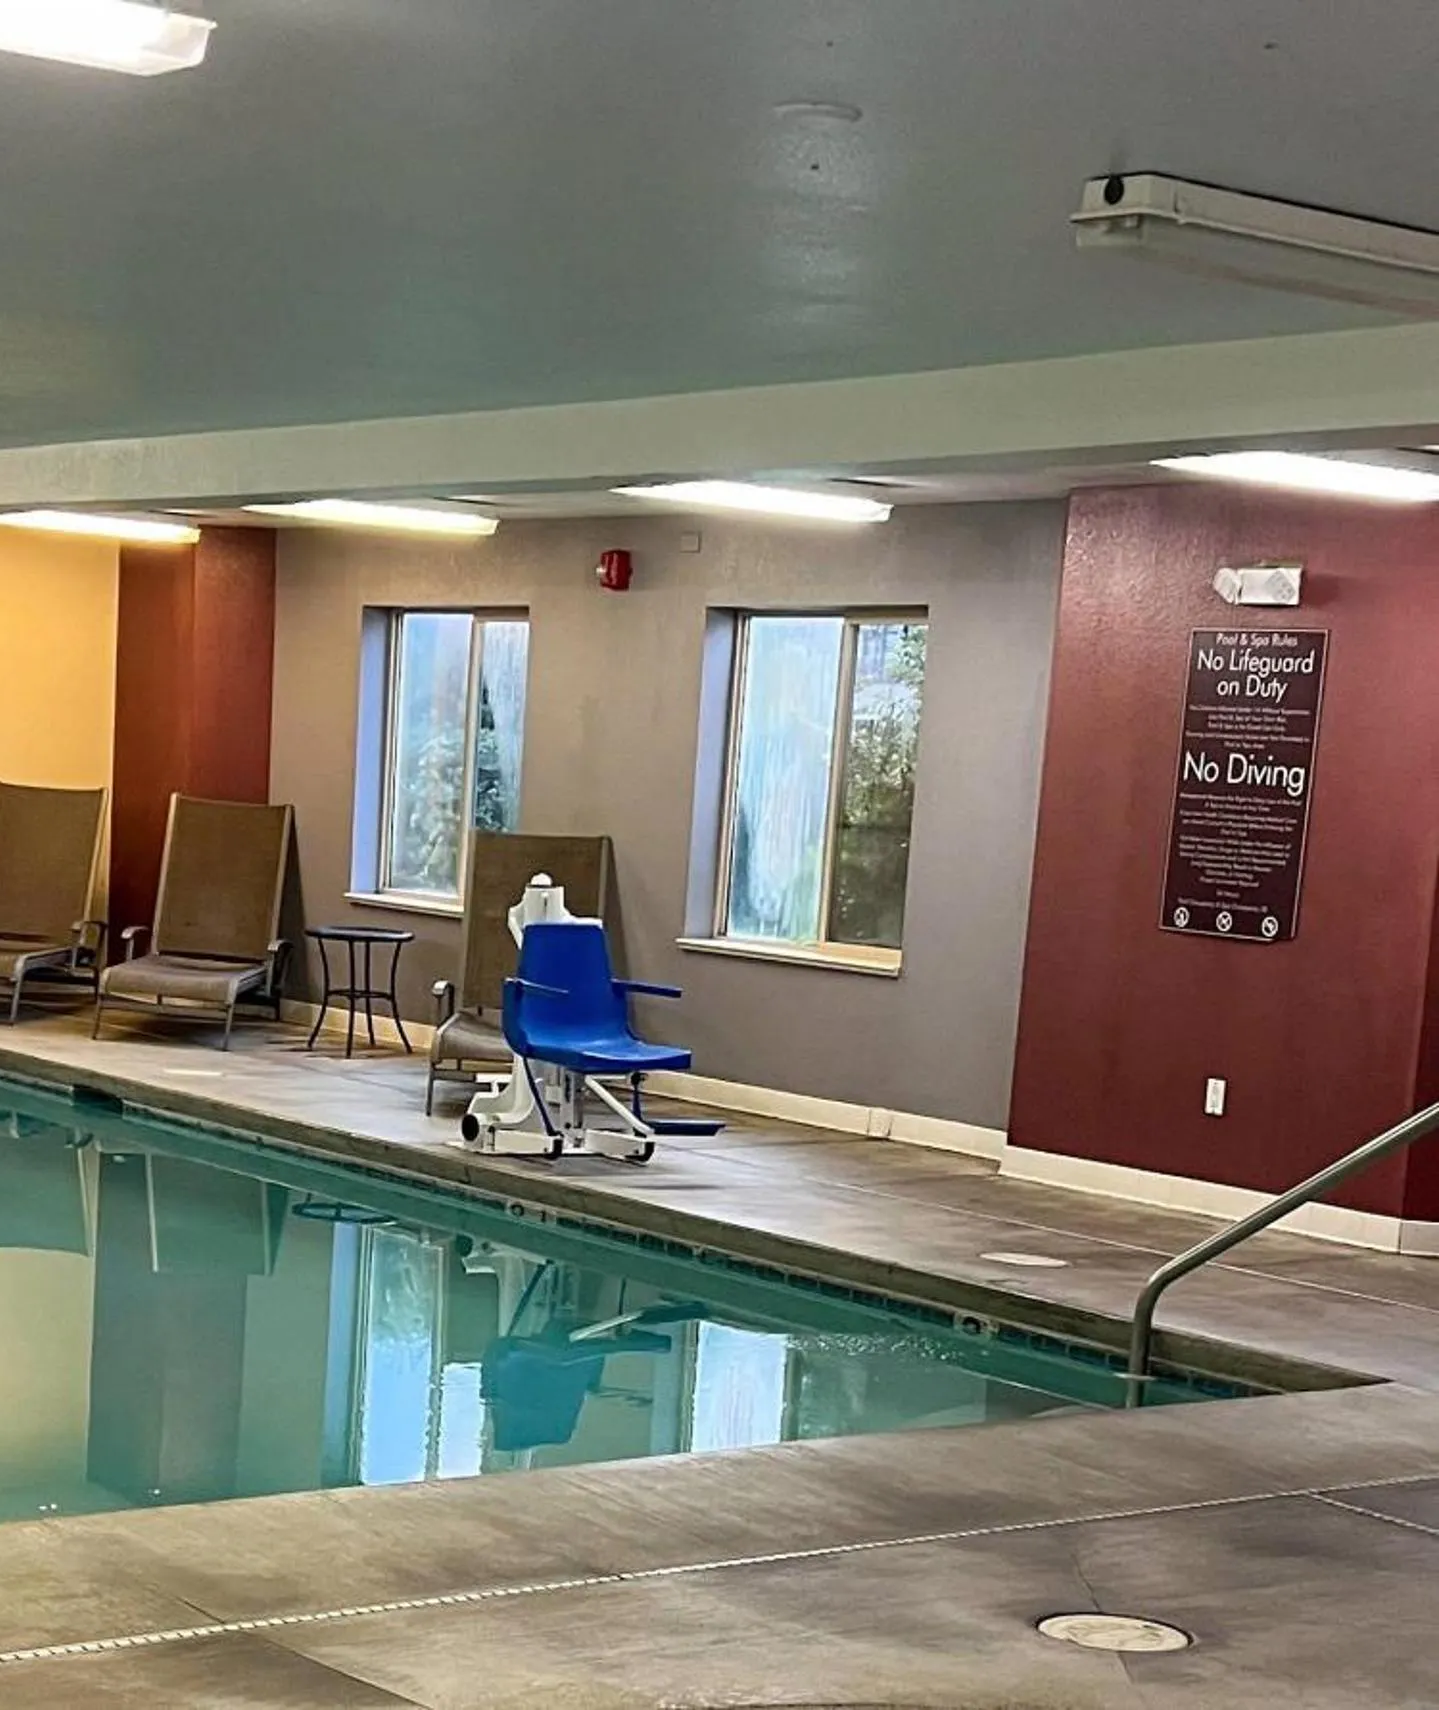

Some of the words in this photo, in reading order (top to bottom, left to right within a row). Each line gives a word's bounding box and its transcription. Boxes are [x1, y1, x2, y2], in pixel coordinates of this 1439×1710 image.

[1216, 633, 1238, 646] Pool
[1240, 633, 1248, 646] &
[1251, 634, 1269, 648] Spa
[1272, 634, 1298, 646] Rules
[1197, 649, 1225, 671] No
[1229, 649, 1315, 677] Lifeguard
[1217, 680, 1240, 696] on
[1245, 675, 1288, 703] Duty
[1183, 751, 1219, 782] No
[1227, 752, 1306, 797] Diving
